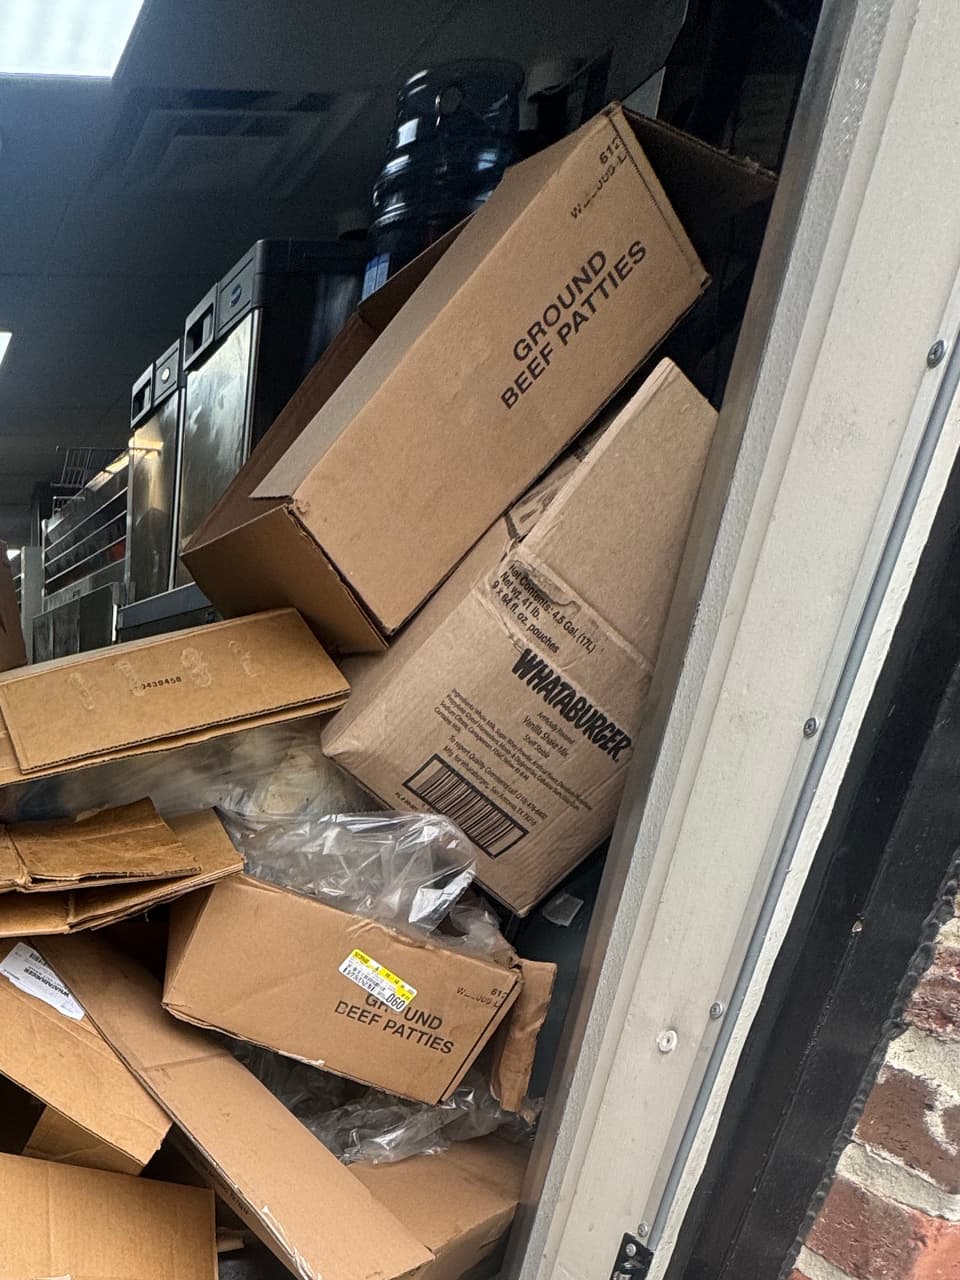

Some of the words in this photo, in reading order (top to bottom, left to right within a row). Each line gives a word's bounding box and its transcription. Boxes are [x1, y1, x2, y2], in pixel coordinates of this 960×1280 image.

[500, 341, 554, 409] BEEF
[556, 240, 647, 346] PATTIES
[512, 251, 607, 361] GROUND
[499, 570, 516, 589] Net
[521, 596, 533, 610] 41
[525, 623, 559, 653] pouches
[511, 648, 633, 762] WHATABURGER
[383, 1018, 455, 1054] PATTIES
